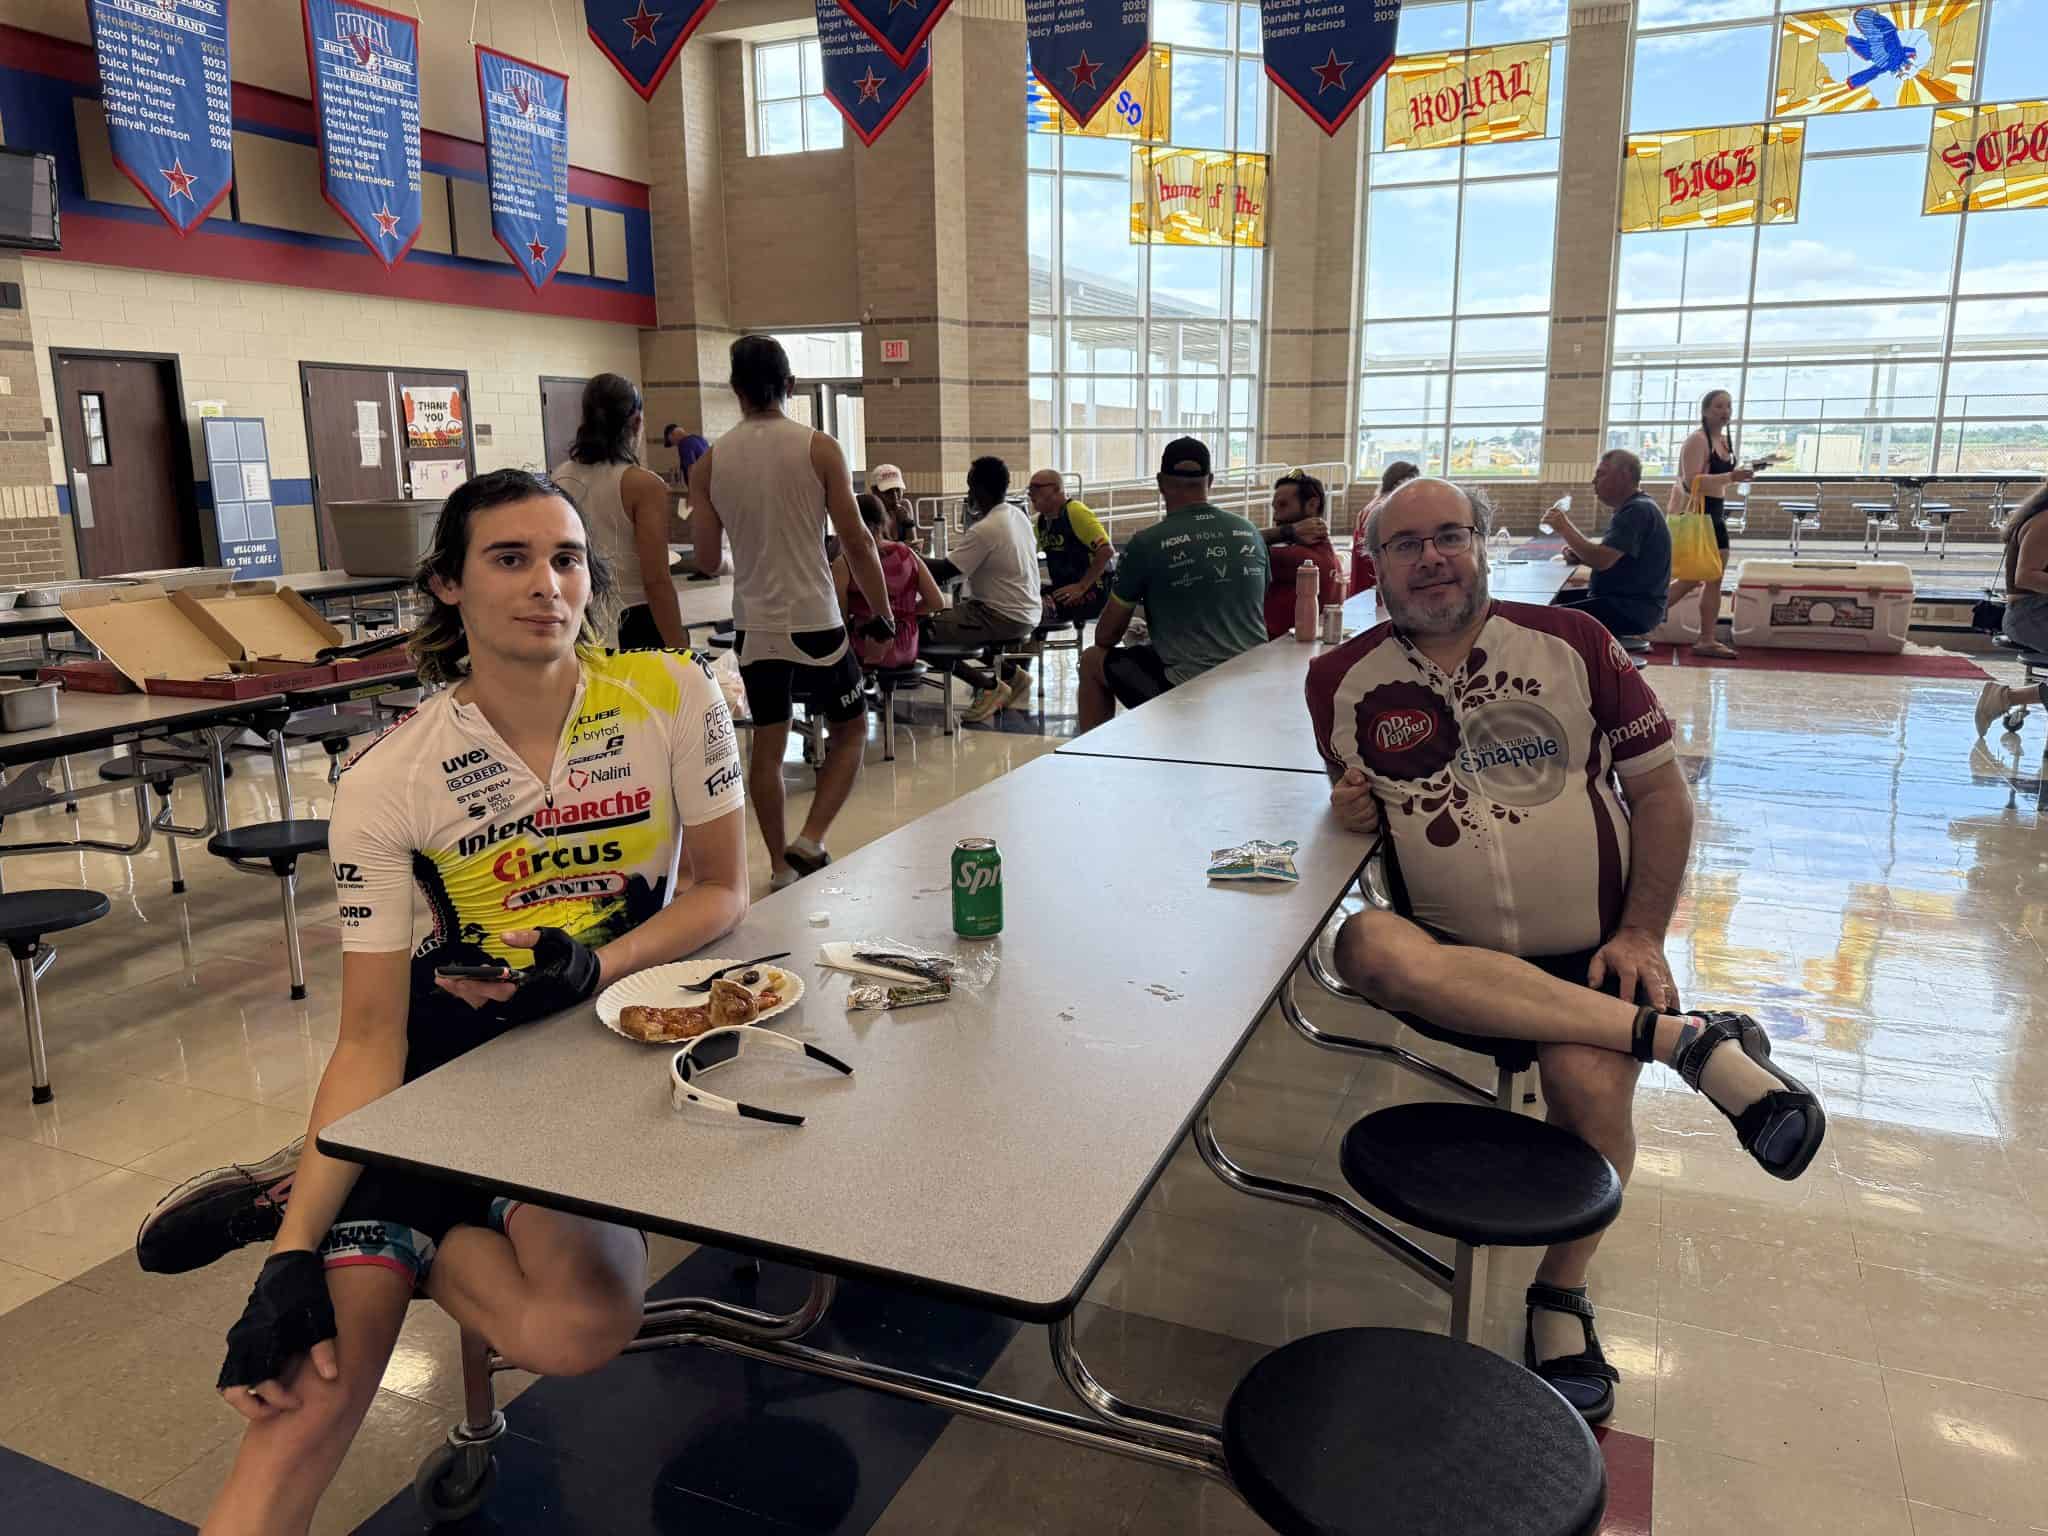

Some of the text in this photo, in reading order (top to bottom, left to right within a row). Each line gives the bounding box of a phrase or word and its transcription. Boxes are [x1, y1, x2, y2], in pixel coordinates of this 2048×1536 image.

[177, 15, 207, 33] BAND
[1054, 19, 1094, 34] Robledo
[1263, 19, 1347, 40] Eleanor Recinos
[97, 24, 128, 42] Jacob
[202, 55, 226, 69] 2023
[97, 40, 227, 83] Devin Ruley 2024
[98, 55, 228, 97] Dulce Hernandez 2024
[100, 71, 133, 87] Edwin
[206, 97, 229, 111] 2024
[102, 85, 231, 124] Joseph Turner 2024
[1409, 61, 1532, 132] ROYAL
[102, 99, 232, 138] Rafael Garces 2024
[104, 114, 147, 132] Timiyah
[149, 124, 191, 142] Johnson
[1209, 182, 1224, 209] of
[417, 401, 448, 411] THANK
[425, 413, 444, 422] YOU
[233, 543, 267, 554] WELCOME
[1160, 533, 1192, 549] HOKA
[226, 557, 236, 567] TO
[238, 556, 252, 566] THE
[583, 722, 620, 741] bryton
[1376, 719, 1427, 749] Pepper
[1390, 716, 1412, 731] Dr
[1460, 735, 1559, 774] Snapple
[450, 763, 503, 788] GOBERT
[591, 762, 631, 784] Nalini
[492, 840, 623, 882] Circus
[519, 877, 612, 905] WANTY
